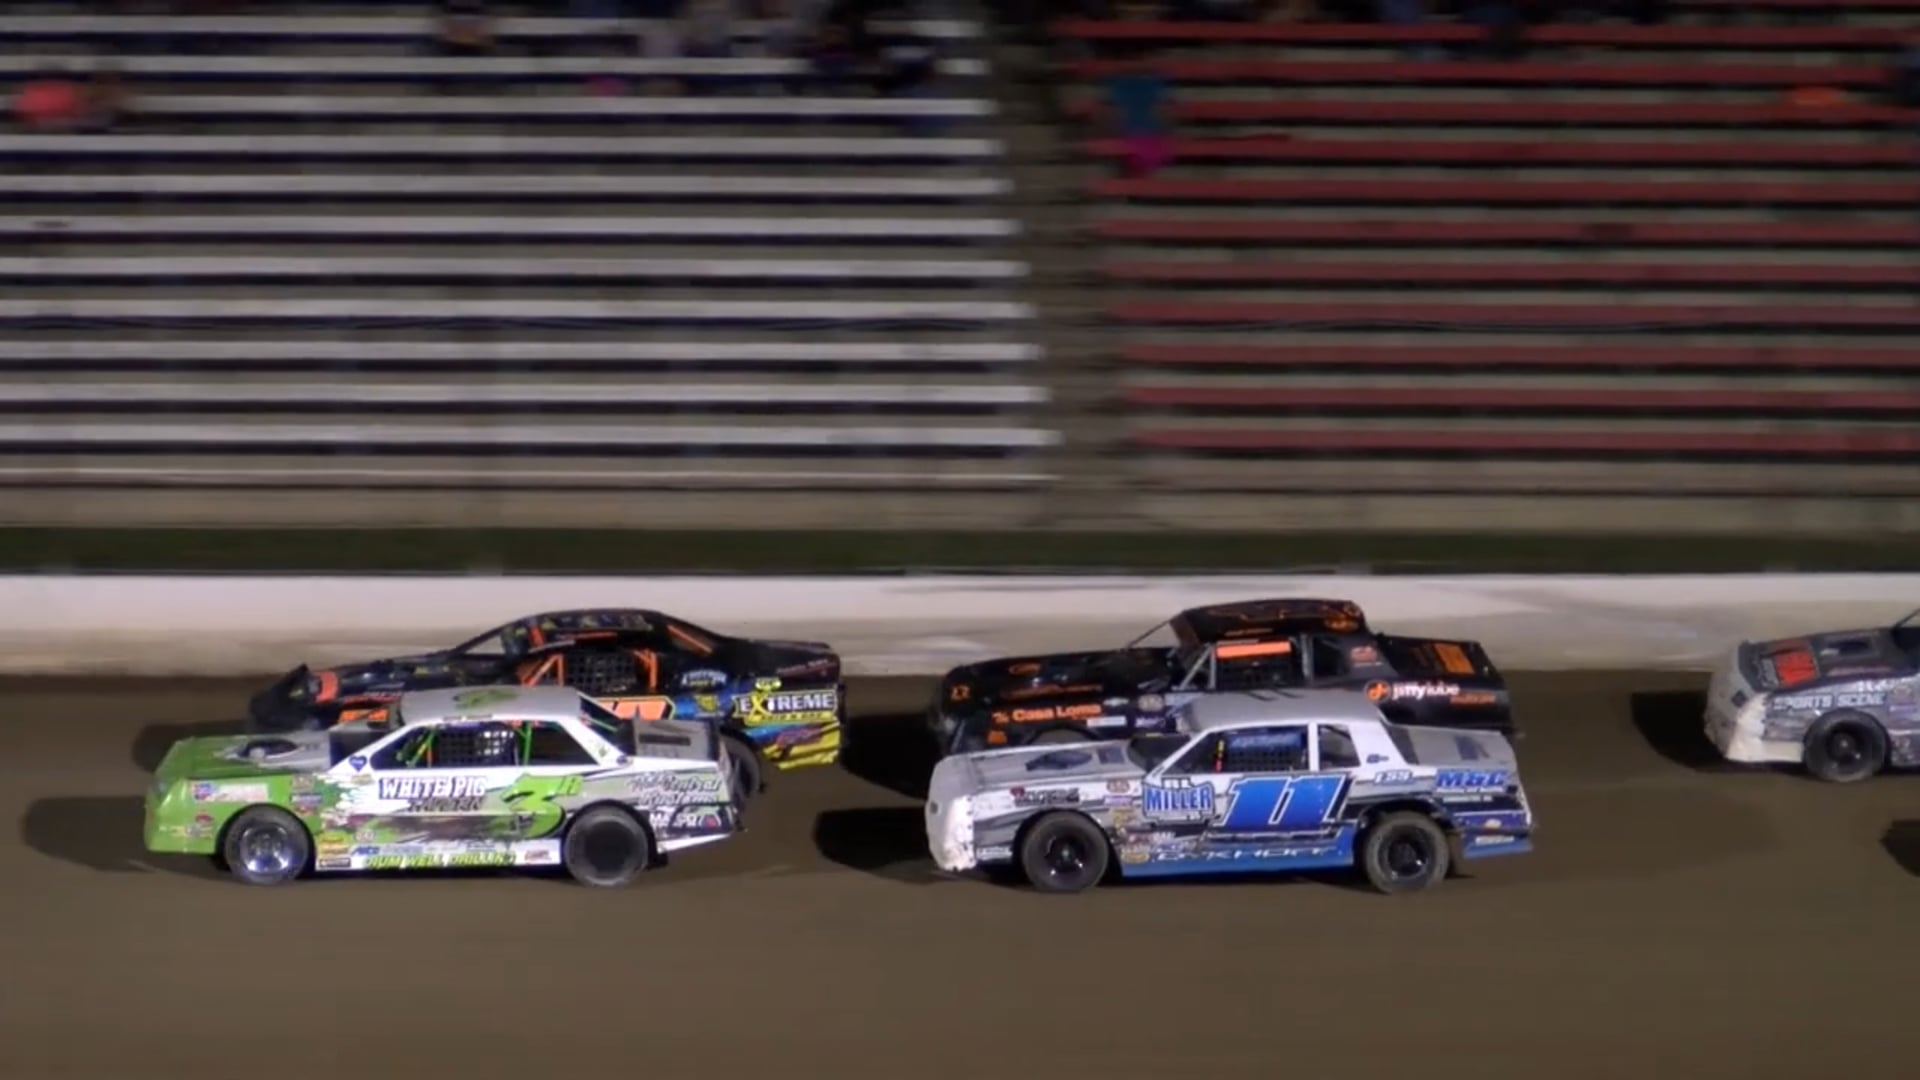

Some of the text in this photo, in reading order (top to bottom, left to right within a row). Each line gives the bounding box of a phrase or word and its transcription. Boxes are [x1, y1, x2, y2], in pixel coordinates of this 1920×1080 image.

[739, 691, 834, 714] EXTREME
[380, 775, 487, 799] WHITE PIG
[1146, 785, 1212, 810] MILLER
[1213, 774, 1347, 832] 11
